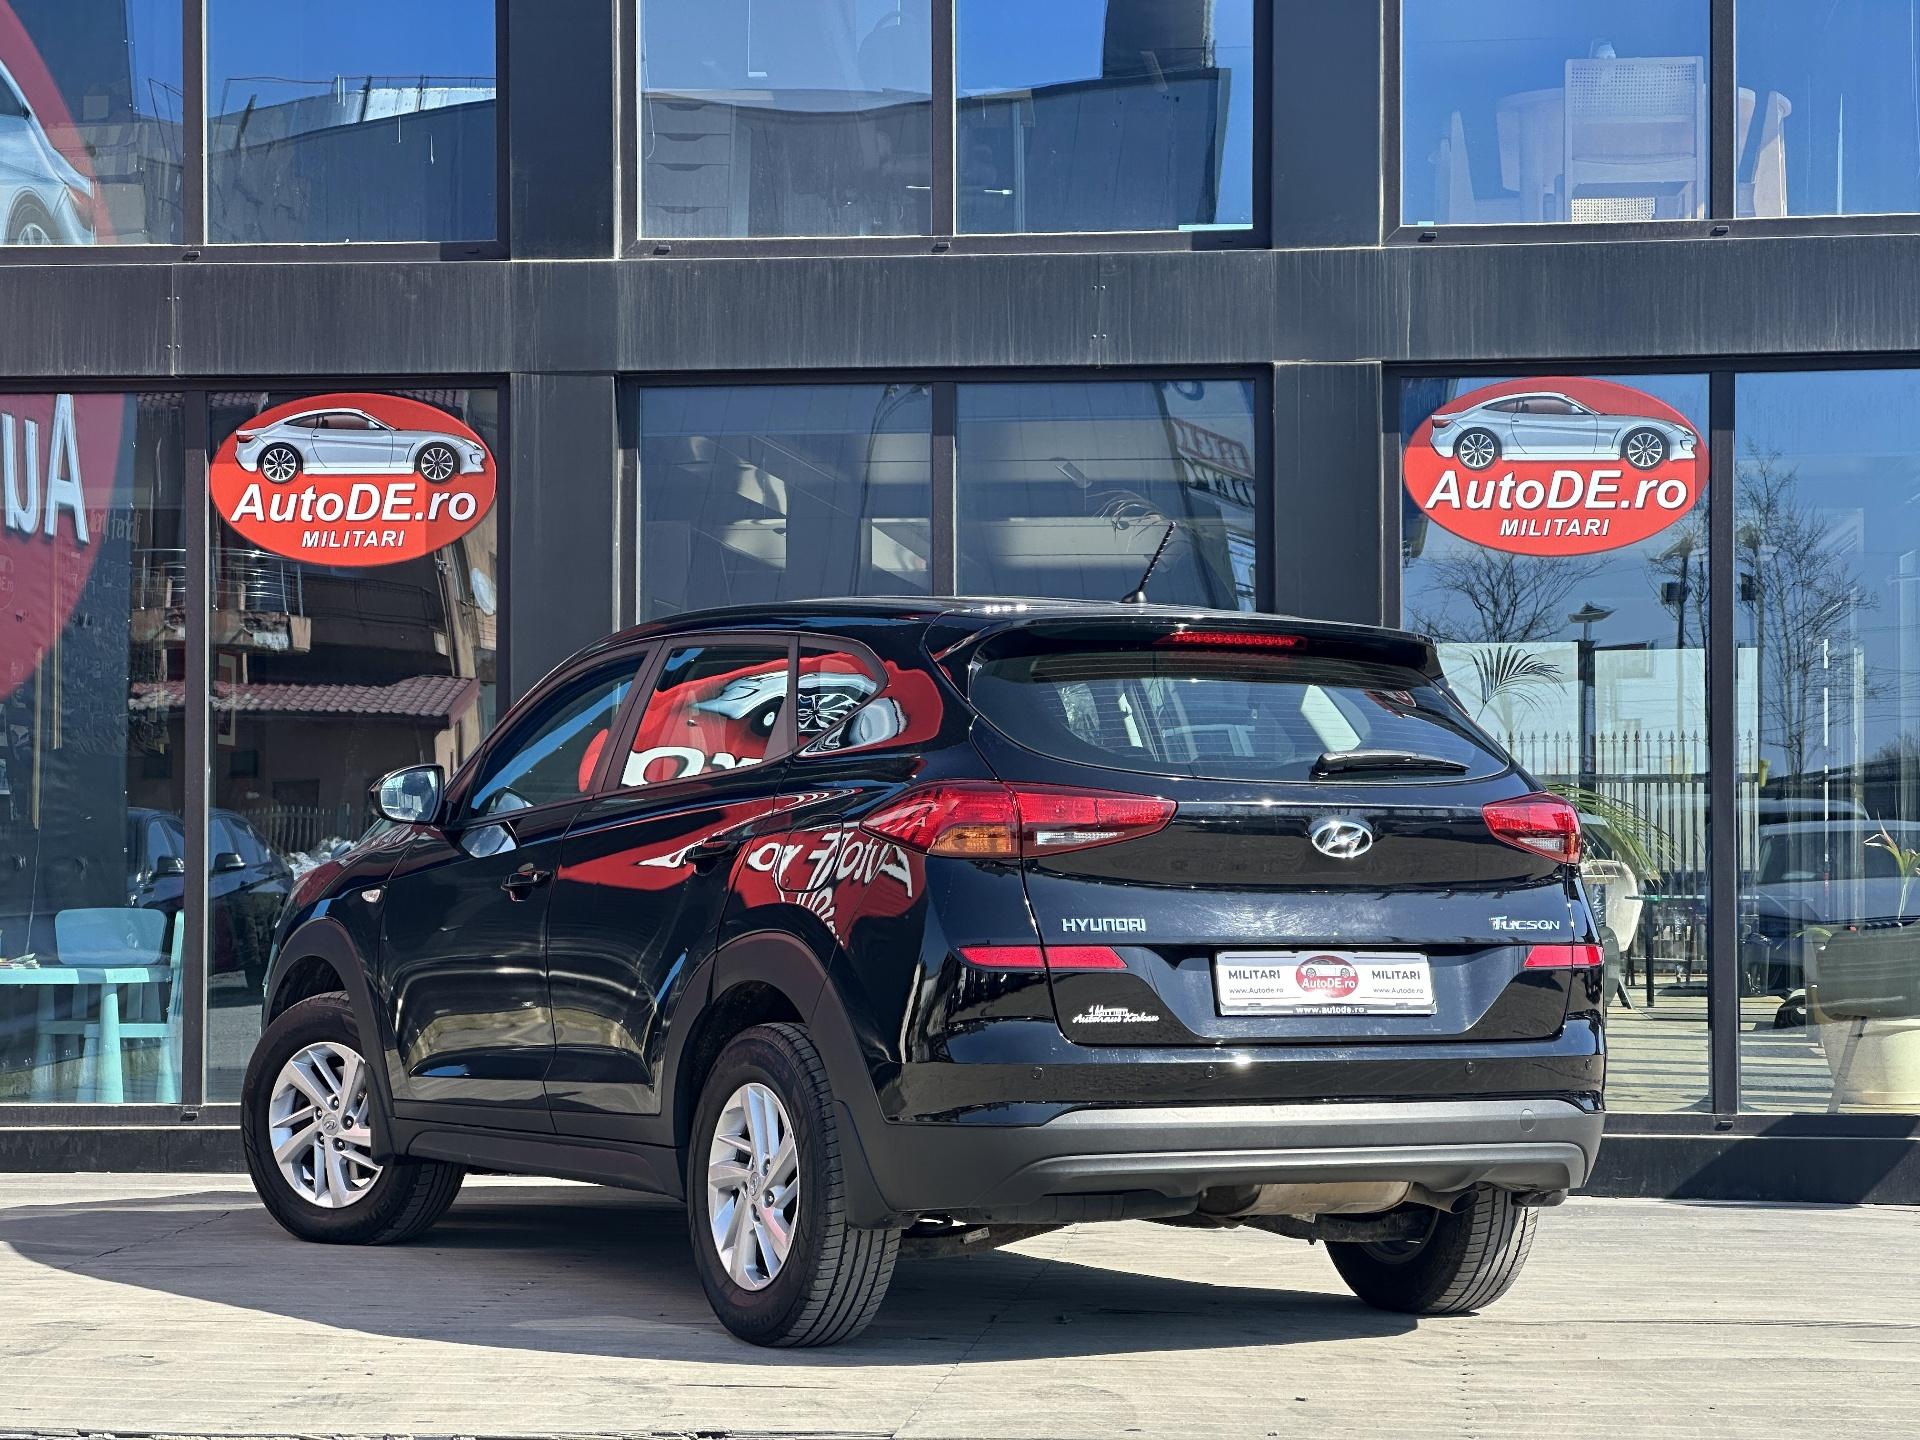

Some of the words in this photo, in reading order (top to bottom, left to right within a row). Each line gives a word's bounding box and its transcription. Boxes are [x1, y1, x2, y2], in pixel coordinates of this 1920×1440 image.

[1425, 470, 1687, 510] AutoDE.ro
[230, 483, 477, 523] AutoDE.ro
[1500, 518, 1610, 537] MILITARI
[301, 530, 405, 548] MILITARI
[1062, 918, 1147, 932] HYUNDAI
[1228, 970, 1281, 980] MILITARI
[1371, 970, 1421, 980] MILITARI
[1301, 977, 1357, 990] AutoDE.ro
[1295, 1005, 1365, 1014] www.autode.ro
